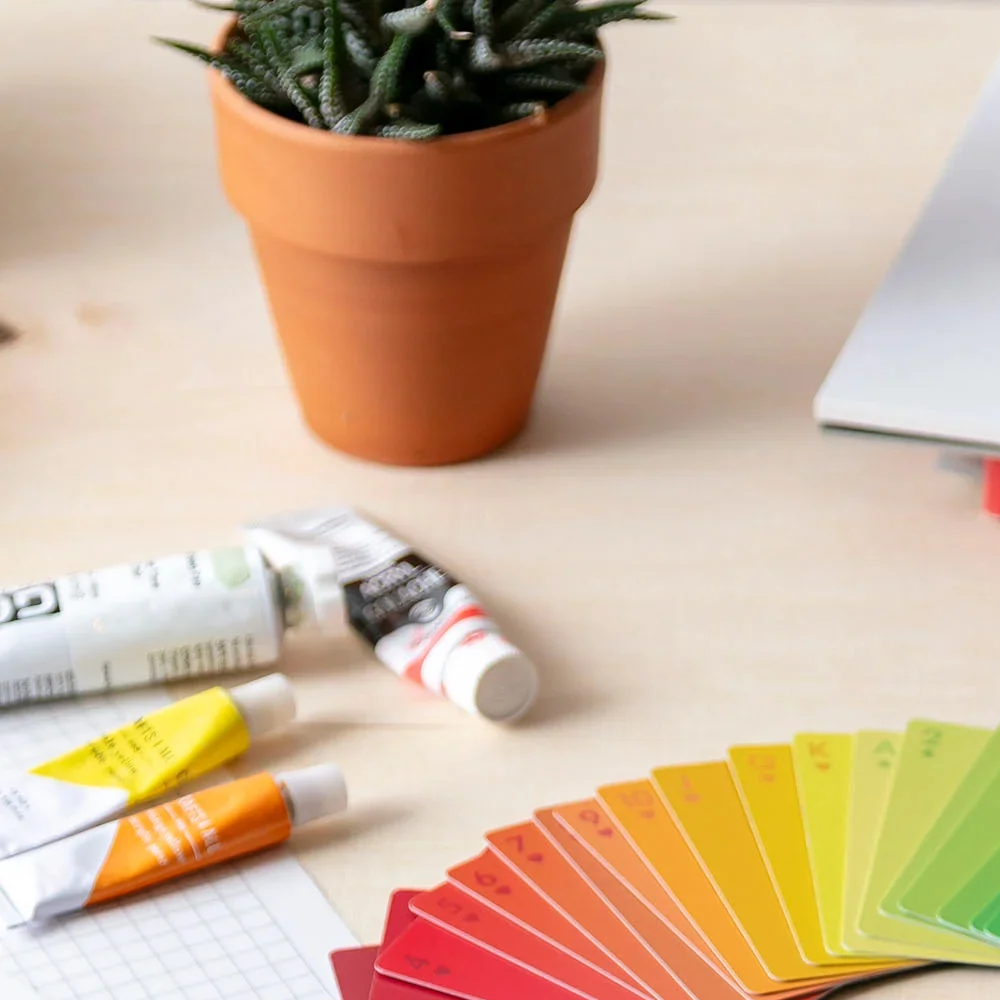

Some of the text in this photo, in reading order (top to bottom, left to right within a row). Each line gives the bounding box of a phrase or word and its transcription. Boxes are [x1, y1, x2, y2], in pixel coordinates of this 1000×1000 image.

[579, 809, 600, 825] 9
[505, 834, 524, 853] 7
[474, 870, 498, 887] 6
[405, 954, 430, 971] 4
